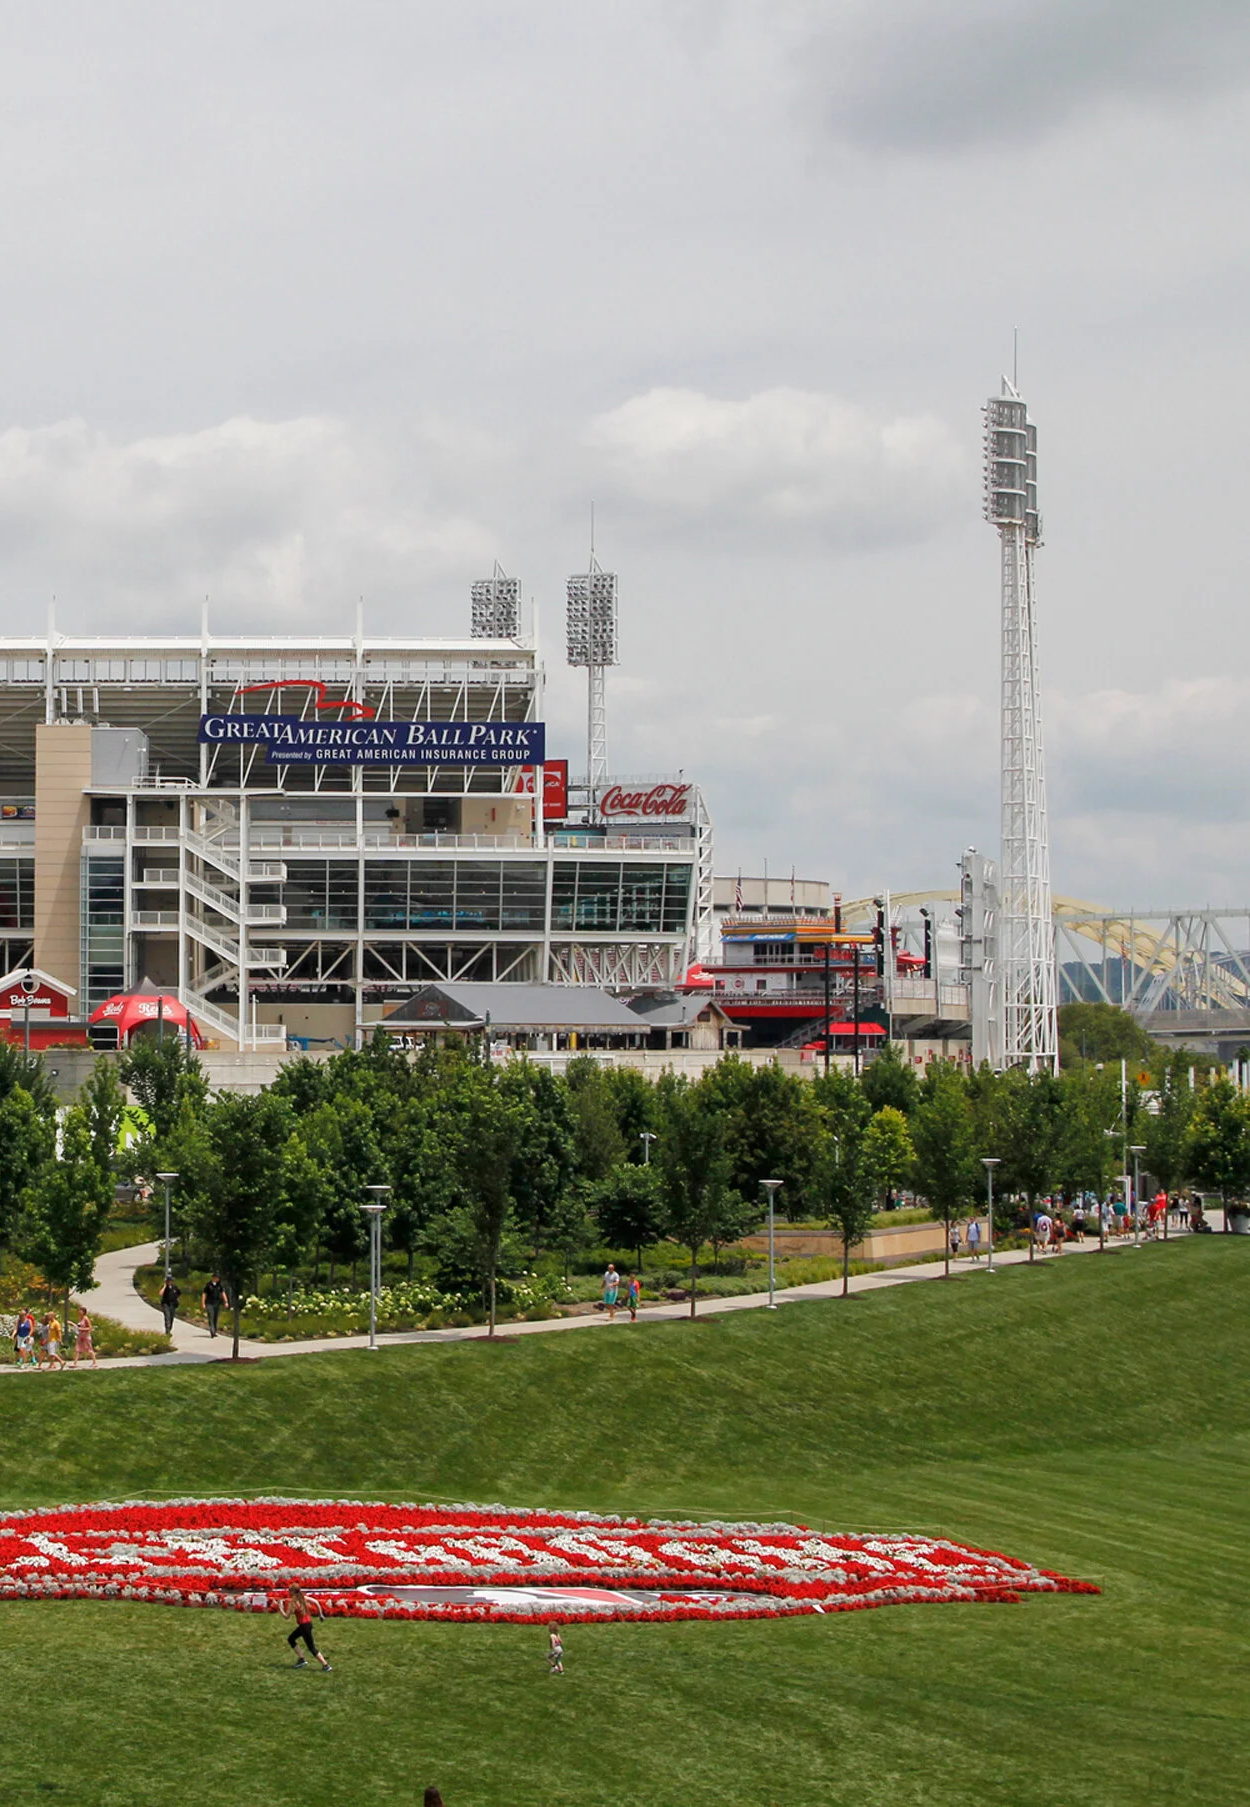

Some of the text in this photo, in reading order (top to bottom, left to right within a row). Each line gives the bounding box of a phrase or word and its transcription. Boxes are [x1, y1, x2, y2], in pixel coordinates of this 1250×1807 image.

[204, 717, 284, 739] GREAT
[276, 724, 398, 745] AMERICAN
[405, 724, 465, 745] BALL
[271, 749, 531, 761] Presented by GREAT AMERICAN INSURANCE GROUP
[600, 783, 693, 817] Coca-Cola
[10, 994, 26, 1006] Bob
[138, 1002, 174, 1017] Res
